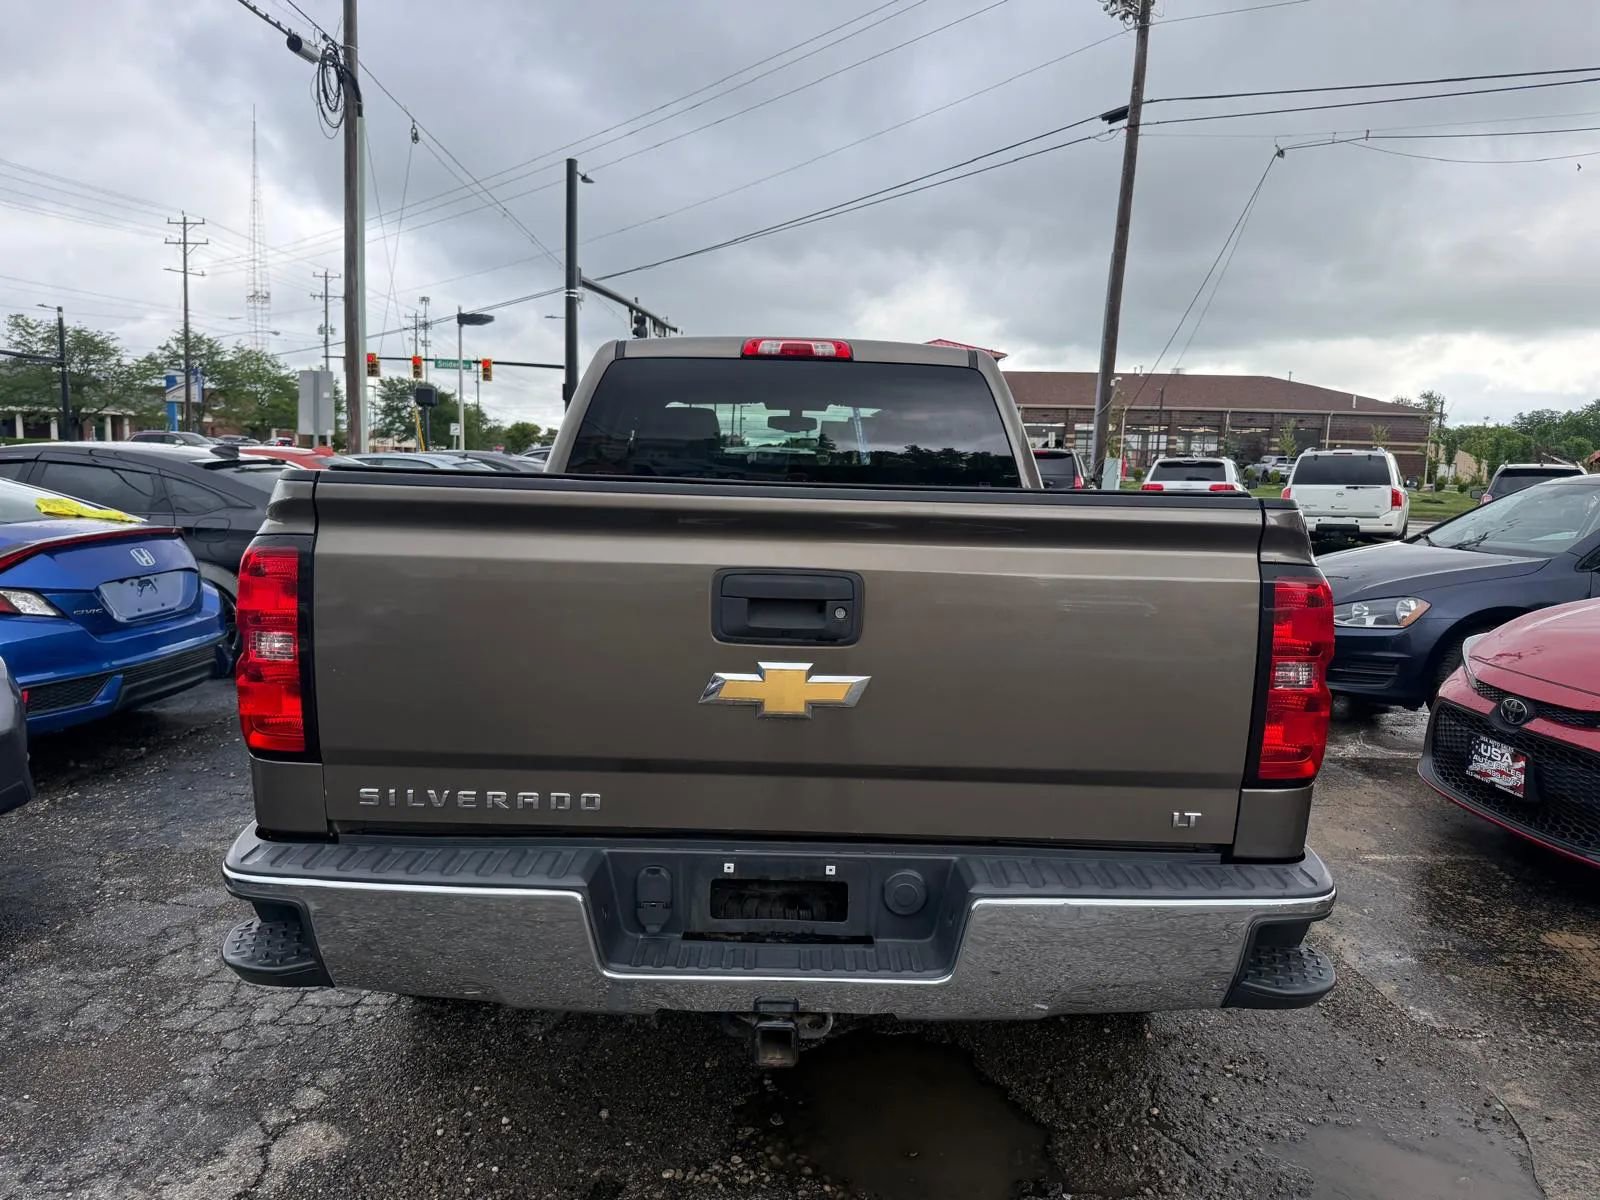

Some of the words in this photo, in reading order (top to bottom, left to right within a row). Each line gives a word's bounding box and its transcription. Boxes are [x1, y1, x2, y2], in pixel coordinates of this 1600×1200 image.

[1481, 743, 1513, 766] USA
[359, 787, 601, 811] SILVERADO
[1173, 812, 1202, 828] LT
